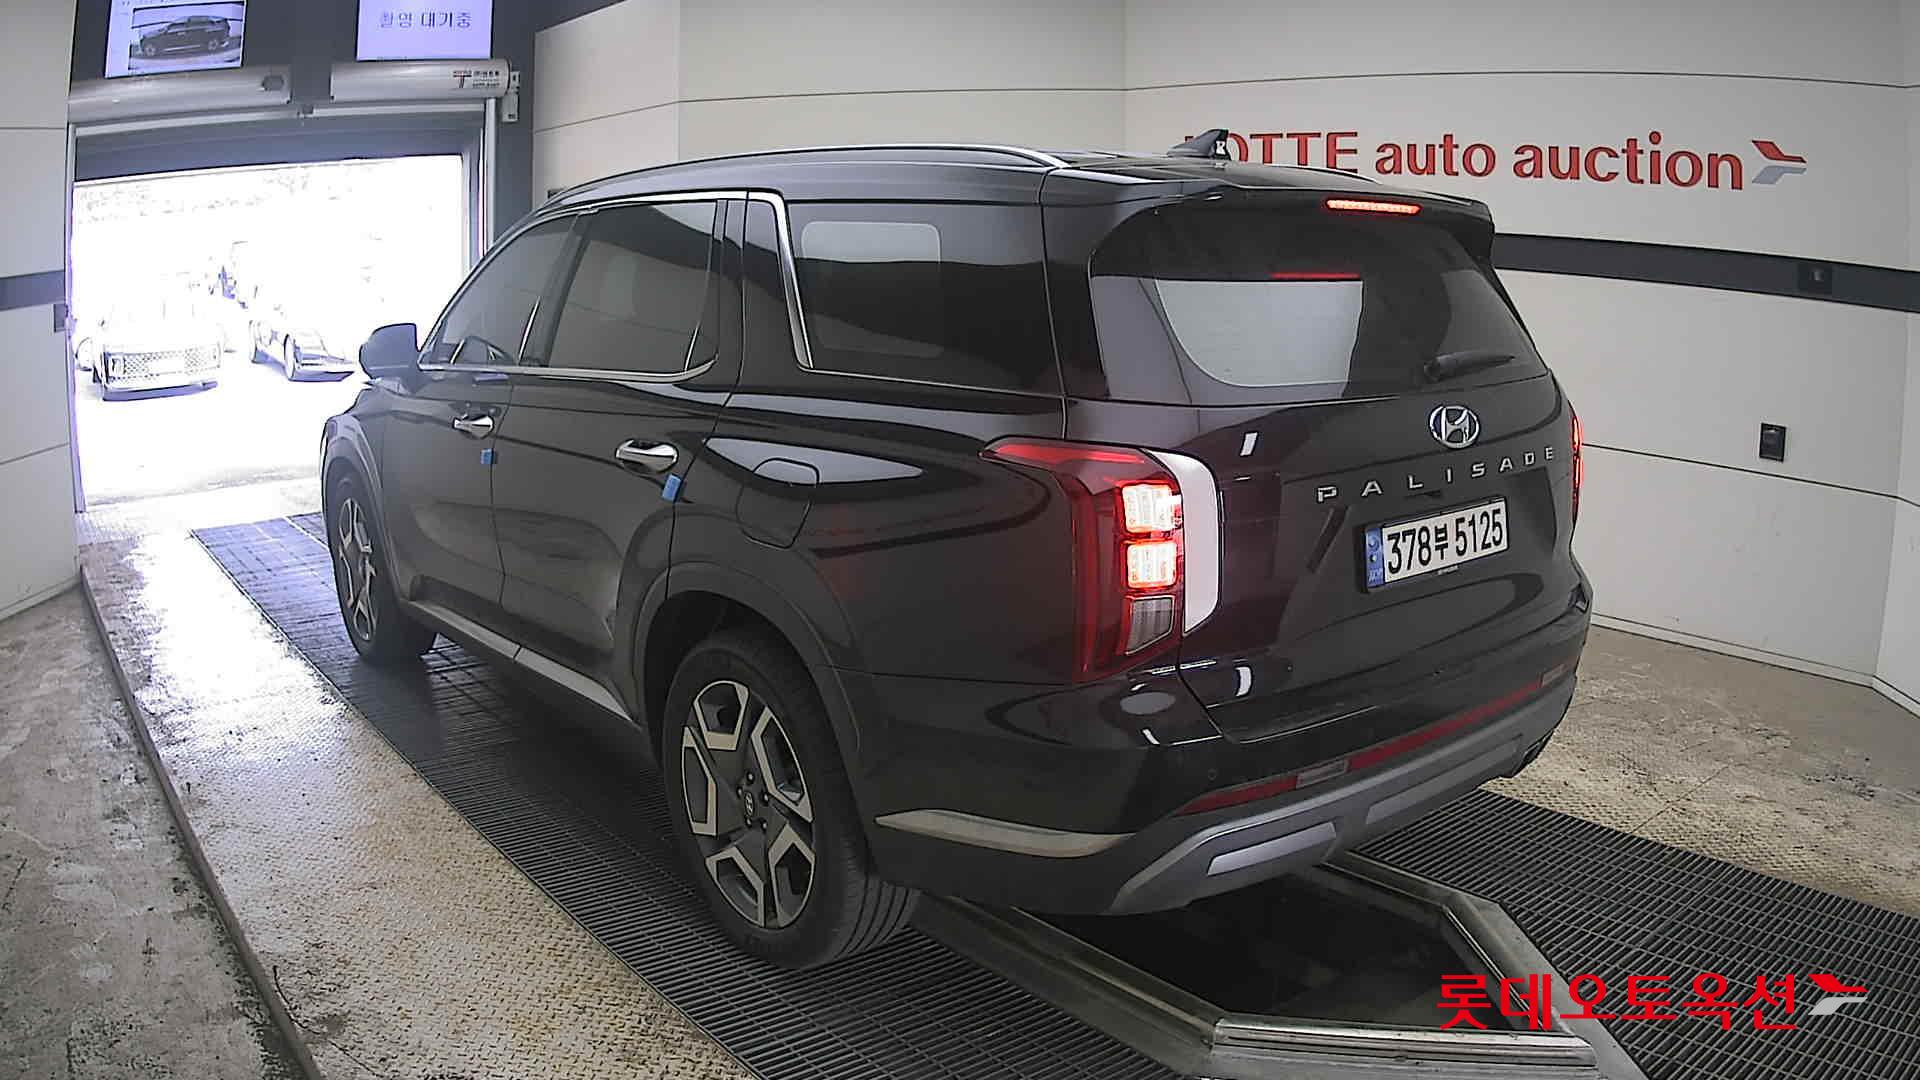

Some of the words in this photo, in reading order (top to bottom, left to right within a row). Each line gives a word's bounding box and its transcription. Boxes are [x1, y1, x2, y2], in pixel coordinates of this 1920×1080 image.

[421, 11, 472, 28] 대기중
[1185, 131, 1358, 173] TTE
[1375, 134, 1496, 177] auto
[1513, 131, 1743, 190] auction
[1316, 446, 1556, 504] PALISADE
[1387, 523, 1449, 575] 378부
[1455, 508, 1504, 557] 5125
